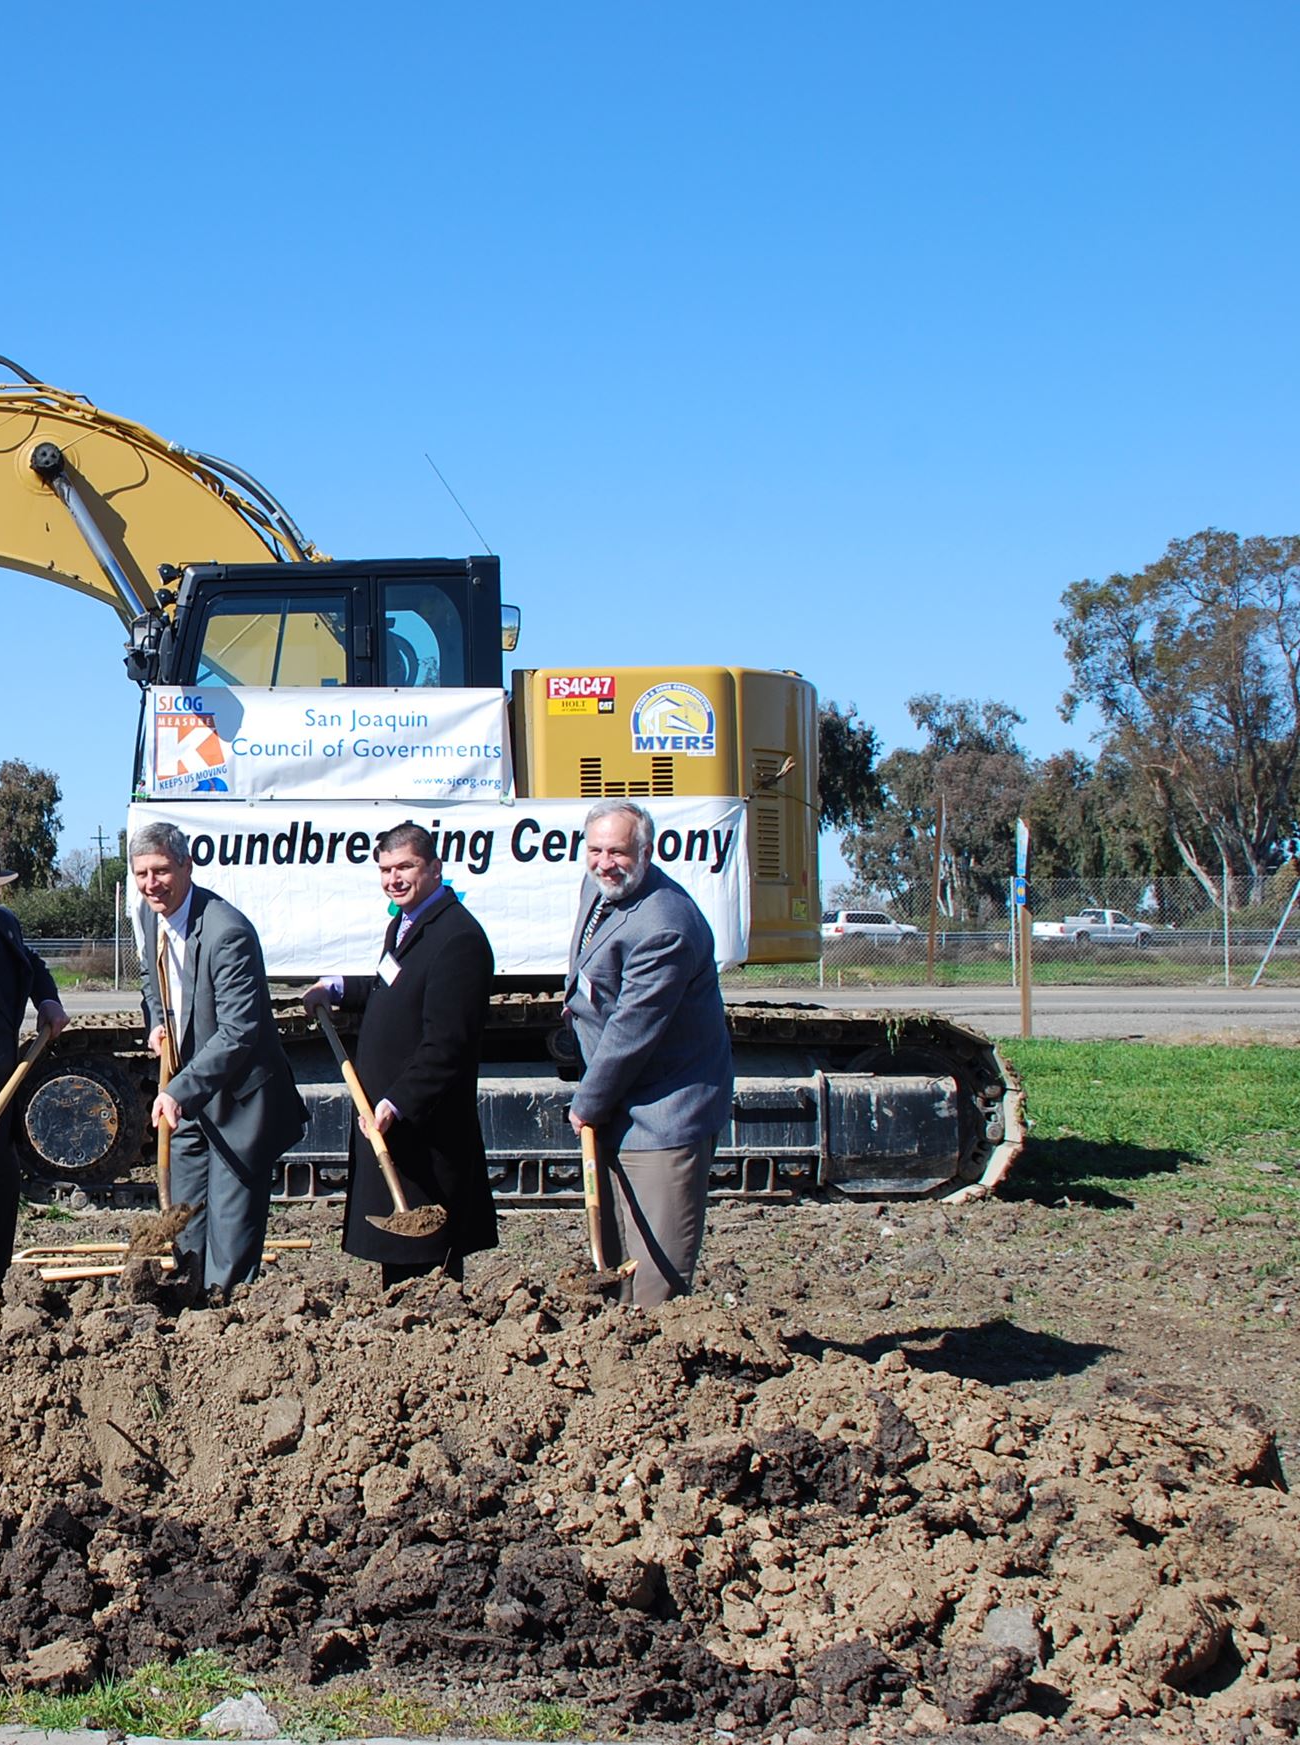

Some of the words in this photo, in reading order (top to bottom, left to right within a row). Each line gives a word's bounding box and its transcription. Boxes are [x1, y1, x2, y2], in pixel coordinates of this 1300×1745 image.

[549, 677, 611, 696] FS4C47
[159, 696, 203, 711] SJCOG
[561, 700, 586, 708] HOLT
[598, 701, 614, 711] CAT
[157, 717, 212, 726] MEASURE
[305, 709, 342, 727] San
[350, 709, 429, 732] Joaquin
[231, 738, 313, 757] Council
[322, 739, 346, 757] of
[353, 738, 502, 758] Governments
[635, 735, 714, 750] MYERS
[159, 776, 183, 790] KEEPS
[184, 774, 195, 783] US
[195, 764, 228, 780] MOVING
[412, 775, 502, 789] www.sjcog.org
[185, 819, 494, 875] oundbreing
[511, 817, 734, 874] Cerony
